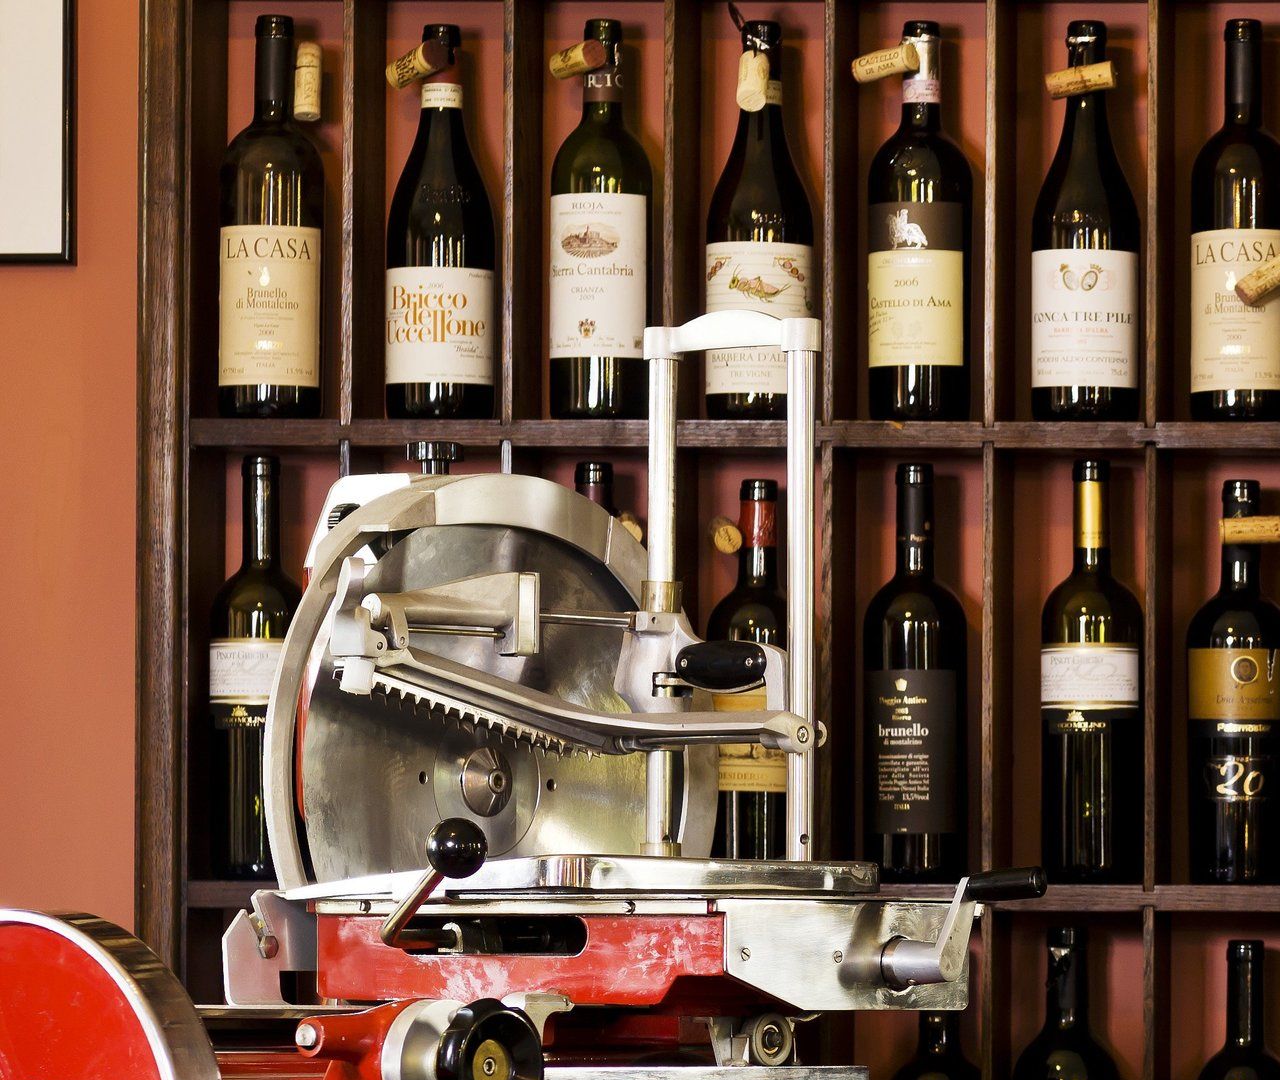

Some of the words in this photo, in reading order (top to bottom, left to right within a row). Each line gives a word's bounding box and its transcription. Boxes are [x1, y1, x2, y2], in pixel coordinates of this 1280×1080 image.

[571, 202, 605, 210] RIOJA
[226, 239, 249, 260] LA
[253, 237, 312, 261] CASA
[1195, 243, 1217, 265] LA
[1220, 240, 1278, 262] CASA
[552, 262, 575, 278] Sierra
[576, 262, 635, 277] Cantabria
[893, 277, 920, 288] 2006
[246, 286, 288, 299] Brunello
[570, 286, 606, 294] CRIANZA
[392, 284, 468, 311] Bricco
[913, 298, 924, 308] DI
[236, 299, 245, 309] di
[246, 299, 300, 310] Montalcino
[1203, 303, 1212, 313] di
[1074, 311, 1104, 324] TRE
[1105, 312, 1134, 325] PILE
[711, 353, 754, 364] BARBERA
[1062, 356, 1079, 365] ALDO
[729, 370, 744, 378] TRE
[745, 370, 772, 378] VIGNE
[216, 651, 238, 661] PINOT
[1050, 655, 1071, 665] PINOT
[902, 694, 928, 705] Antico
[878, 723, 930, 738] brunello
[883, 737, 890, 745] di
[891, 737, 922, 745] montalcino
